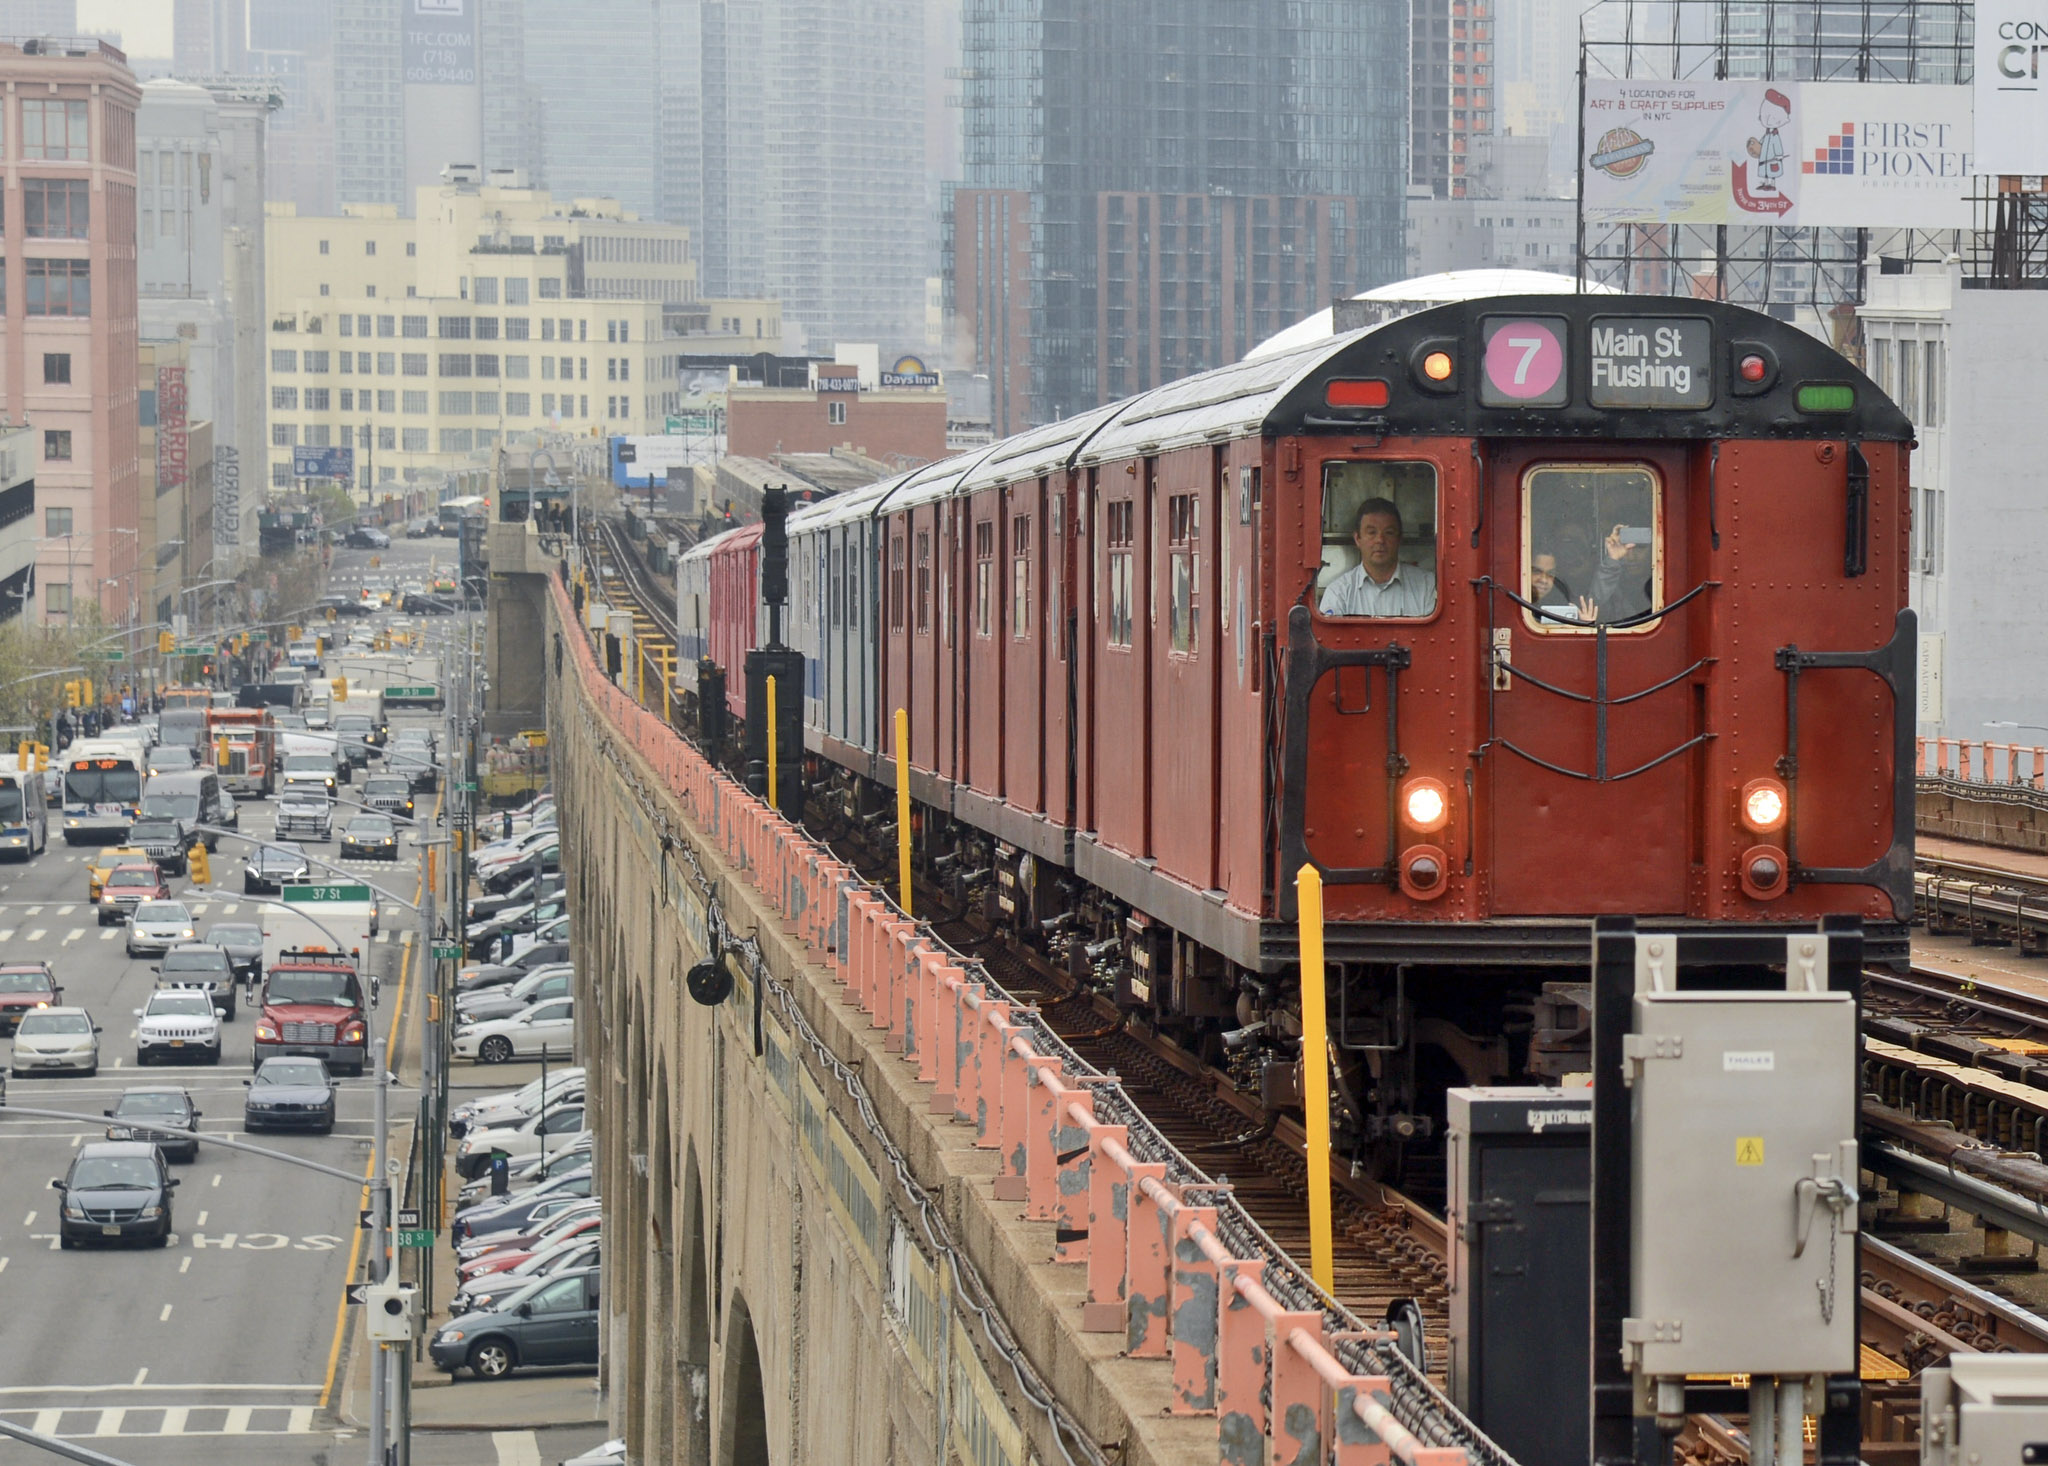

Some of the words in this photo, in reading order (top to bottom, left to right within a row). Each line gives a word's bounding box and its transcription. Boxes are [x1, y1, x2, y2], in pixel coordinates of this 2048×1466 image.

[408, 32, 471, 47] TFC.COM
[424, 50, 457, 66] (718)
[407, 68, 474, 82] 606-9440
[1620, 89, 1626, 98] 4
[1629, 90, 1676, 98] LOCATIONS
[1678, 90, 1695, 98] FOR
[1590, 101, 1614, 110] ART
[1618, 101, 1625, 110] &
[1630, 101, 1667, 110] CRAFT
[1672, 101, 1725, 110] SUPPLIES
[1861, 122, 1951, 148] FIRST
[1861, 151, 1974, 177] PIONEE
[1778, 201, 1788, 209] ST
[1592, 327, 1649, 357] Main
[1655, 327, 1682, 357] St
[1508, 338, 1542, 385] 7
[884, 374, 914, 387] Days
[915, 375, 936, 386] Inn
[1592, 358, 1691, 394] Flushing
[313, 888, 326, 899] 37
[330, 887, 341, 899] St
[439, 948, 448, 958] 37
[30, 1232, 344, 1250] SCHL
